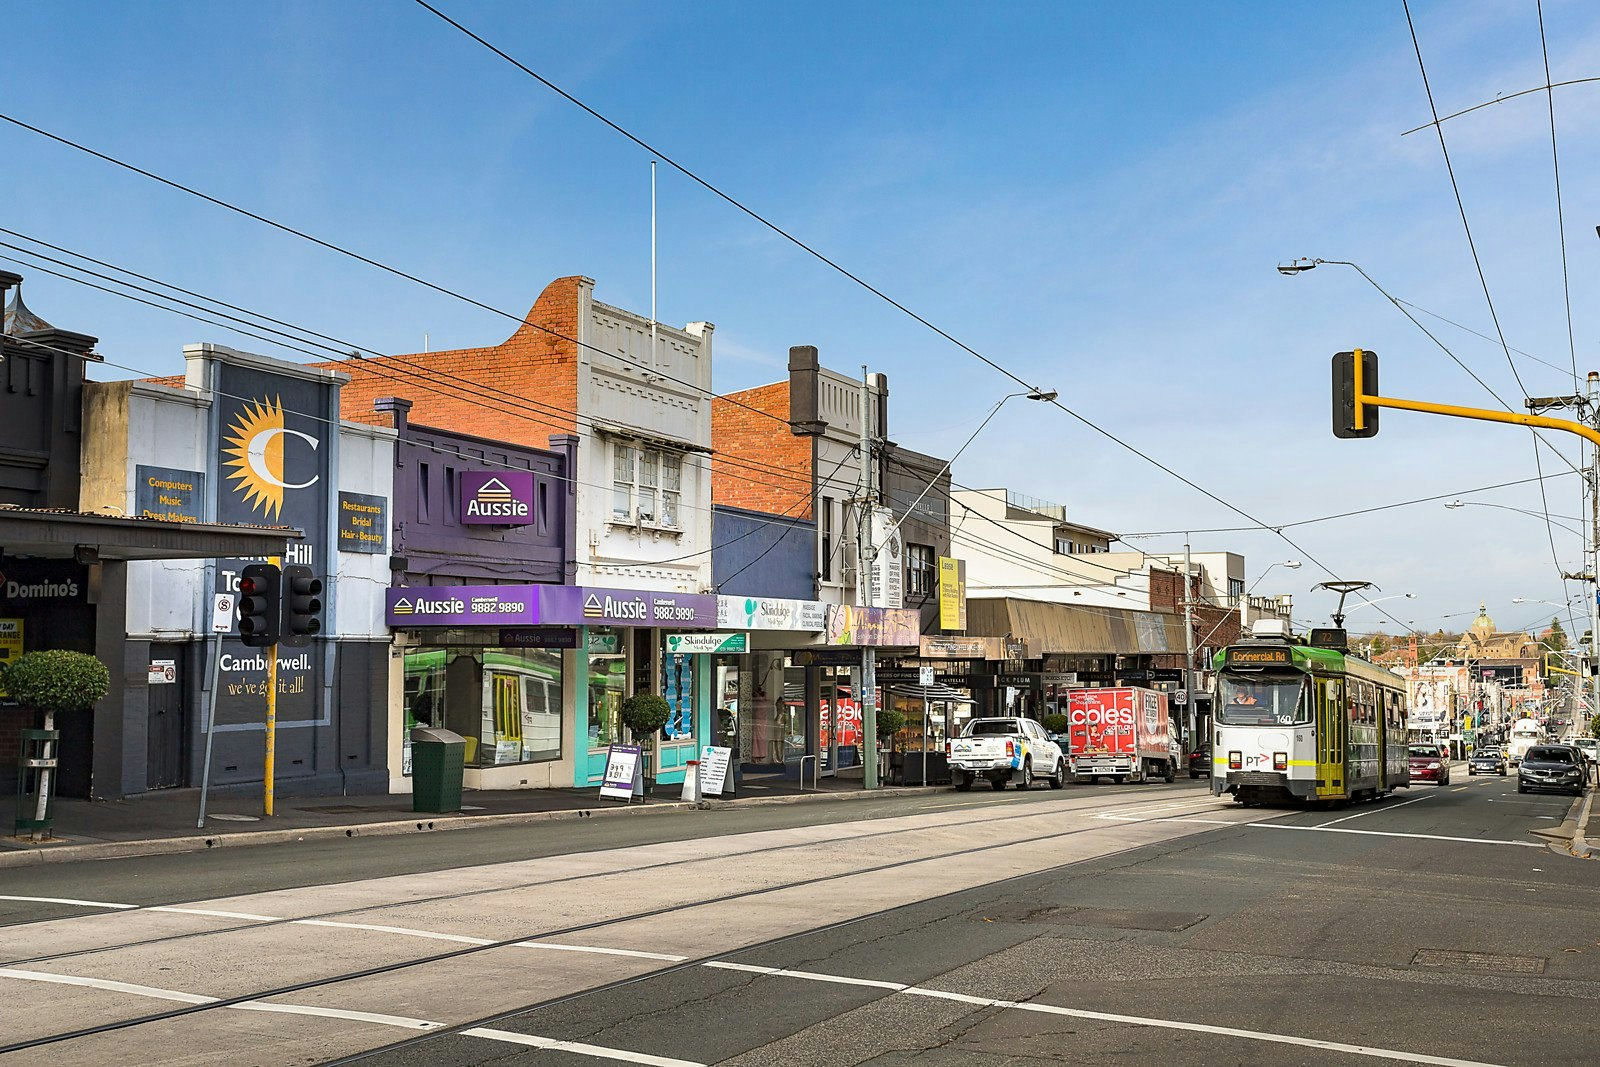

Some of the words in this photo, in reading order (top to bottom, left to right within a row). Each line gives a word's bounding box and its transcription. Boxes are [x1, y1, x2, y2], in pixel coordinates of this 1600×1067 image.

[148, 476, 193, 491] Computers
[159, 494, 182, 506] Music
[342, 500, 381, 514] Restaurants
[467, 499, 528, 516] Aussie
[167, 511, 197, 523] Makers
[352, 516, 372, 527] Bridal
[285, 543, 313, 565] Hill
[6, 578, 78, 599] Domino's
[414, 597, 465, 614] Aussie
[471, 602, 497, 613] 9882
[498, 602, 524, 613] 9890
[603, 595, 647, 620] Aussie
[761, 601, 790, 620] Skindulge
[653, 606, 675, 620] 9882
[675, 607, 695, 621] 9890
[2, 623, 15, 631] DAY
[514, 634, 541, 644] Aussie
[684, 635, 722, 647] Skindulge
[219, 653, 312, 671] Cambrwell.
[1232, 651, 1273, 662] Commercial
[1275, 651, 1286, 661] Rd
[228, 677, 256, 696] we've
[278, 678, 286, 694] it
[289, 675, 304, 694] all!
[1176, 693, 1186, 701] 40
[1071, 704, 1133, 725] coles
[1276, 714, 1292, 724] 160
[1246, 756, 1261, 767] PT
